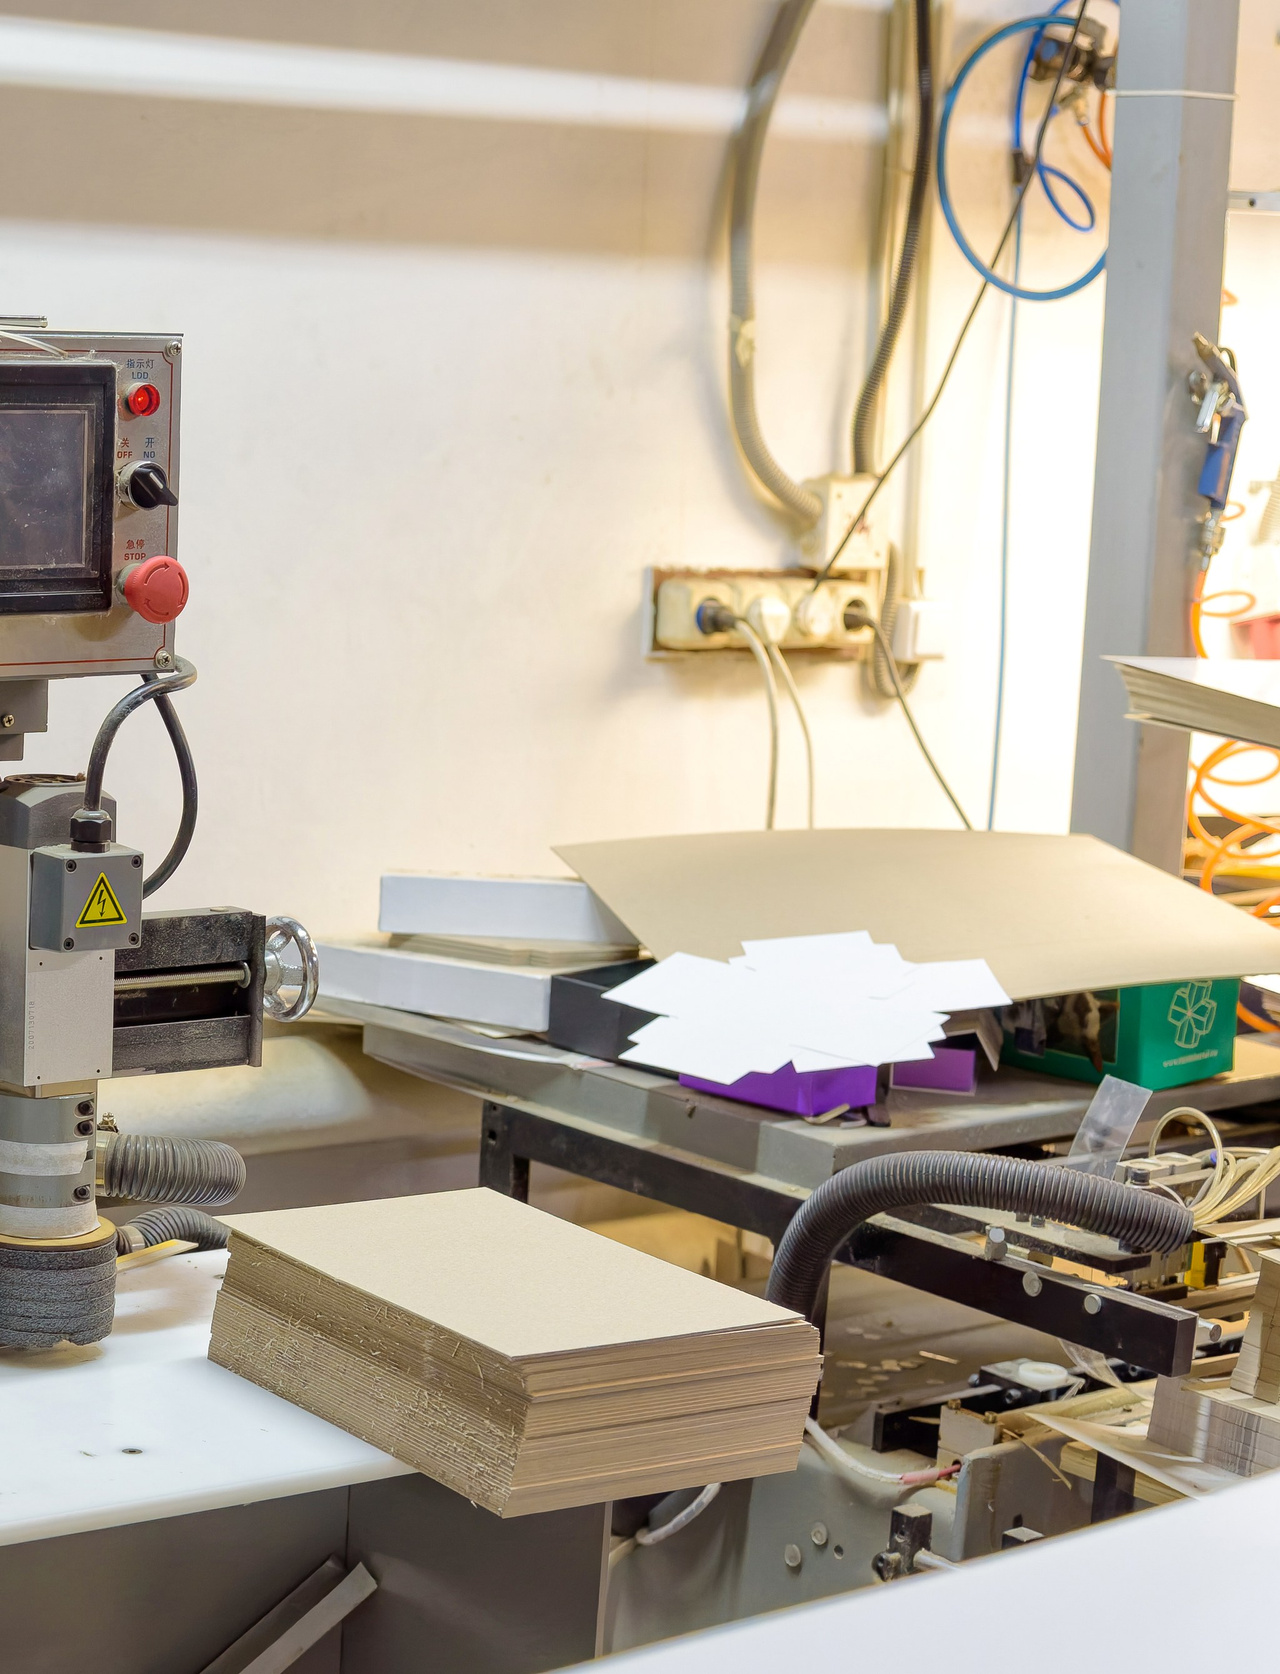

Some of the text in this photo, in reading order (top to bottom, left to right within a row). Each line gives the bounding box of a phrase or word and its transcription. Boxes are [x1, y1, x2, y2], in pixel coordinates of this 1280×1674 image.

[126, 358, 155, 370] 指示灯
[131, 371, 149, 380] LDD
[120, 438, 130, 448] 关
[145, 437, 155, 449] 开
[117, 451, 133, 459] OFF
[143, 451, 156, 459] NO
[126, 539, 146, 550] 急停
[124, 552, 147, 561] STOP
